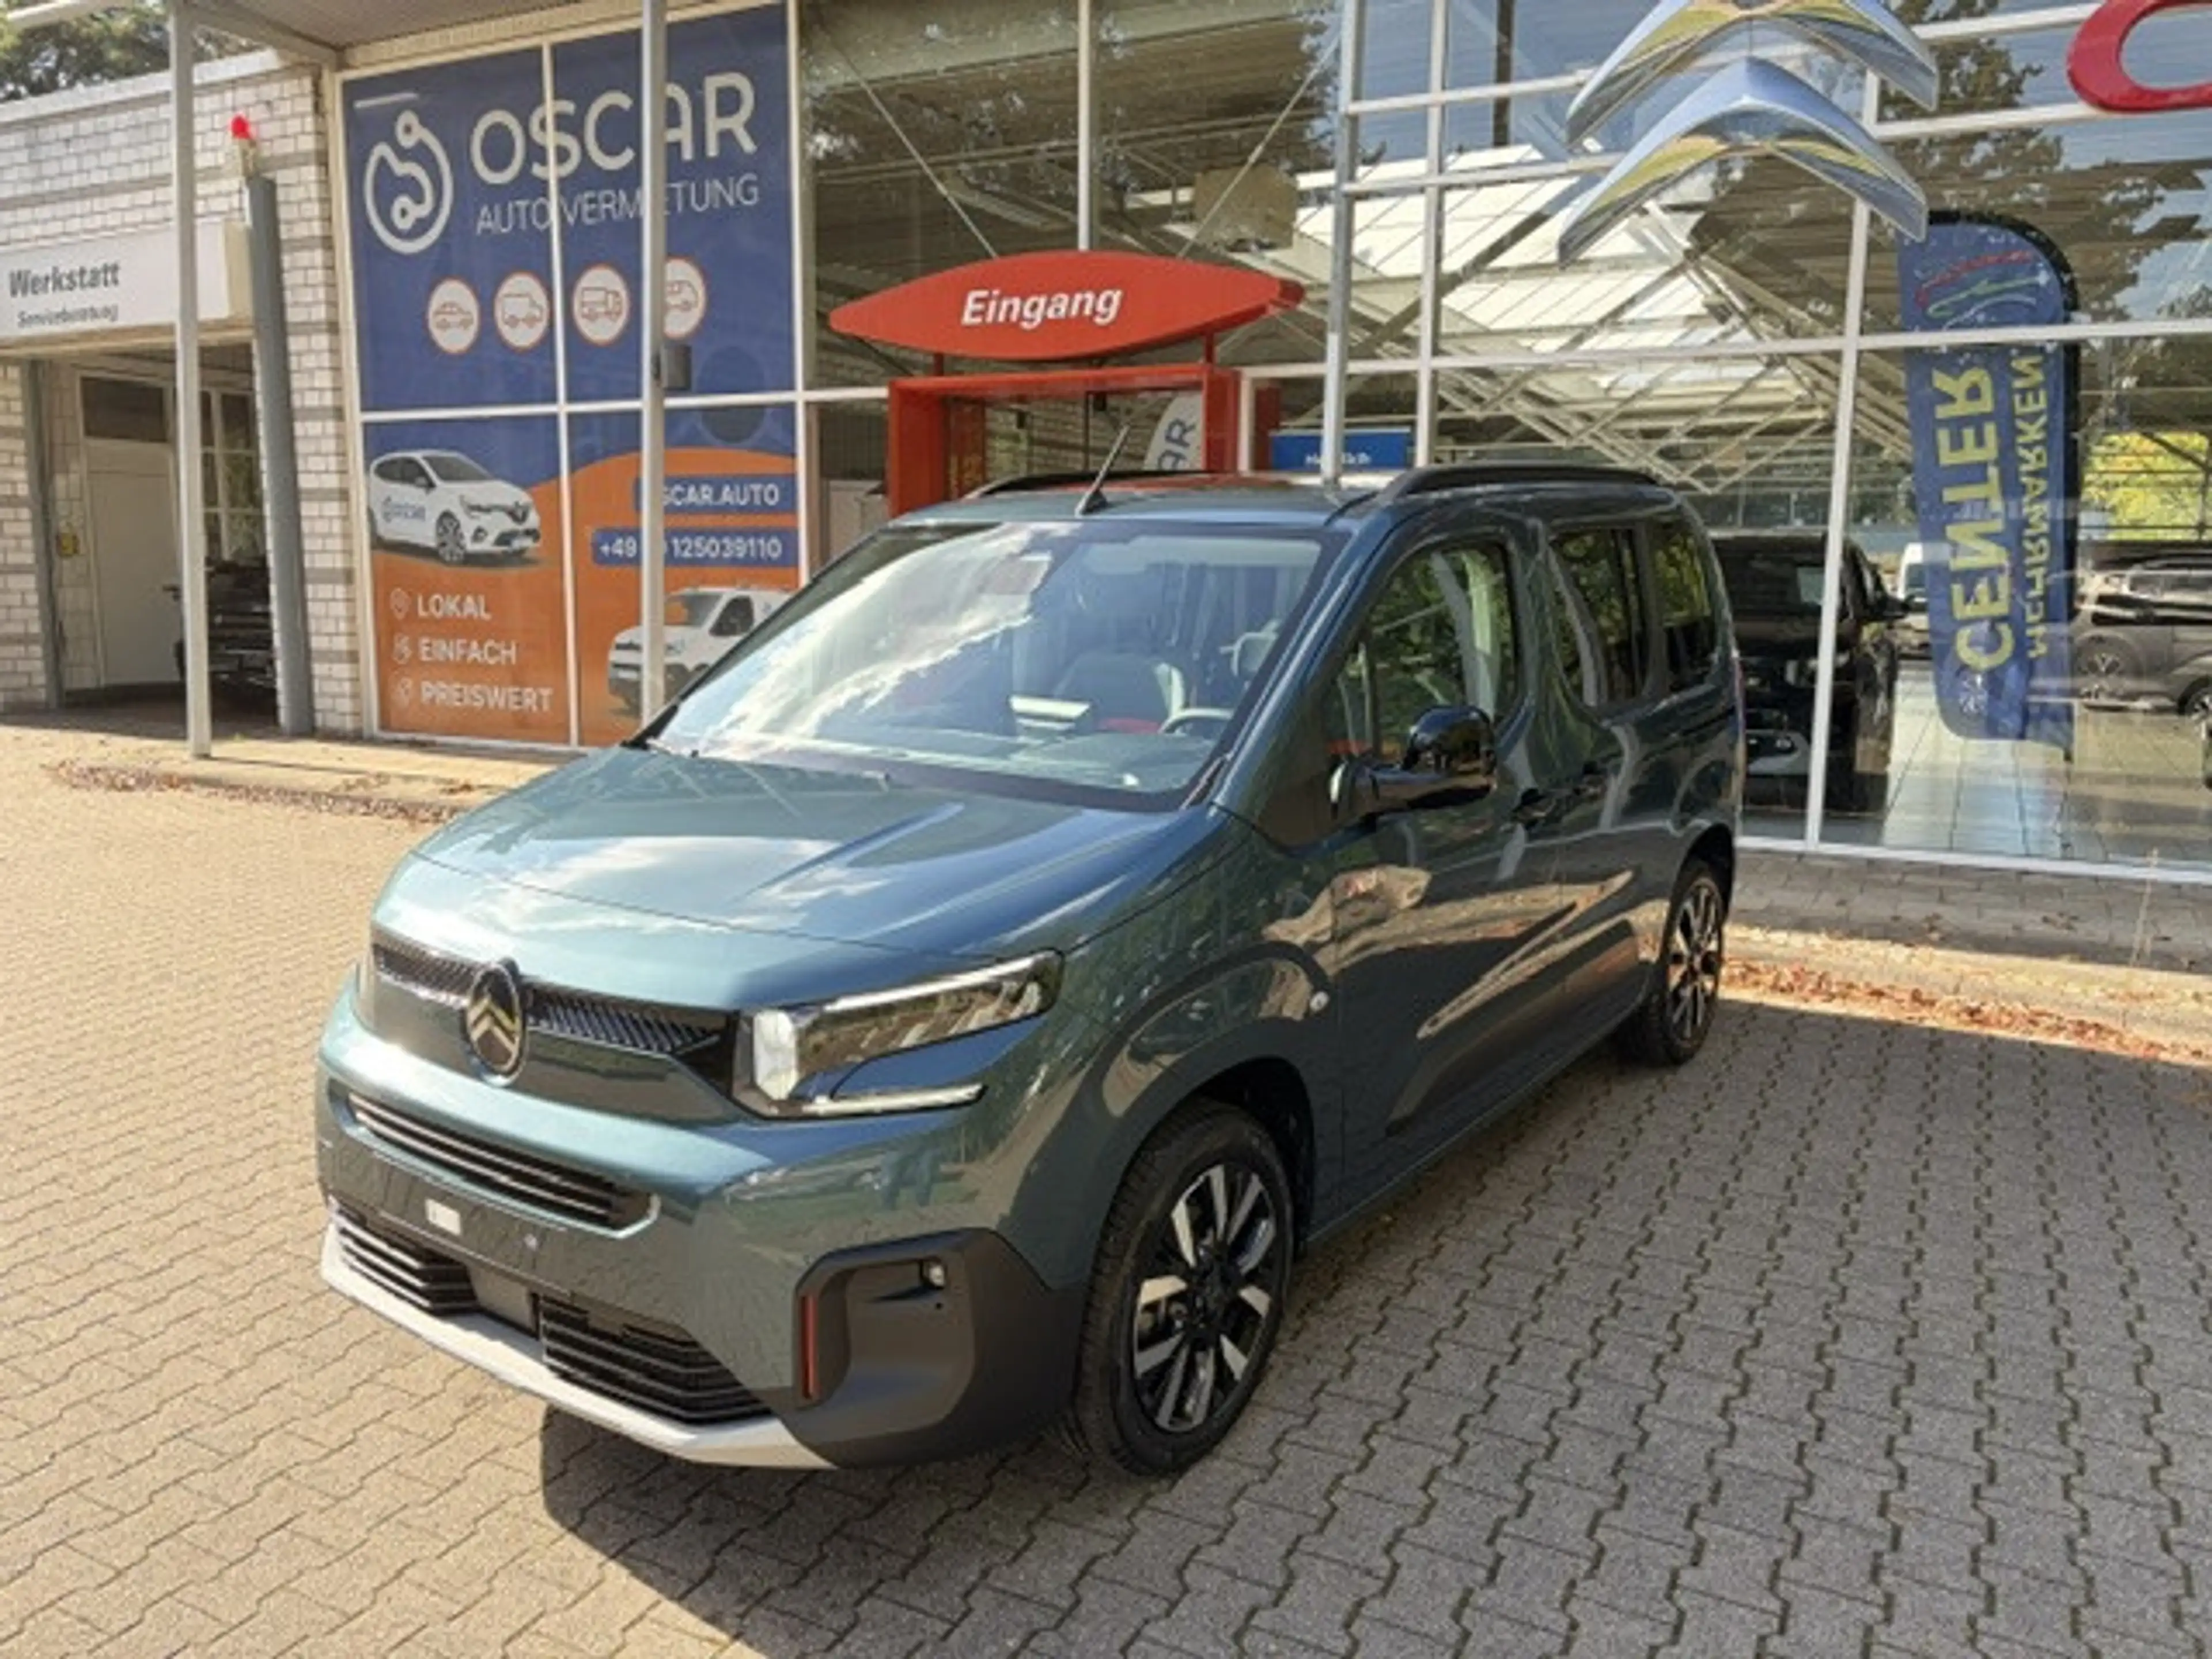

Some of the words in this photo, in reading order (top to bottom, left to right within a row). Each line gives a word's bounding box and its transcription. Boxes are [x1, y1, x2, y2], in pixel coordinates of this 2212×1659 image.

[476, 173, 761, 235] AUTOVERMTUNG
[9, 261, 121, 298] Werkstatt
[961, 289, 1123, 331] Eingang
[661, 482, 779, 505] SCAR.AUTO
[417, 593, 492, 620] LOKAL
[418, 638, 517, 665] EINFACH
[420, 683, 554, 713] PREISWERT
